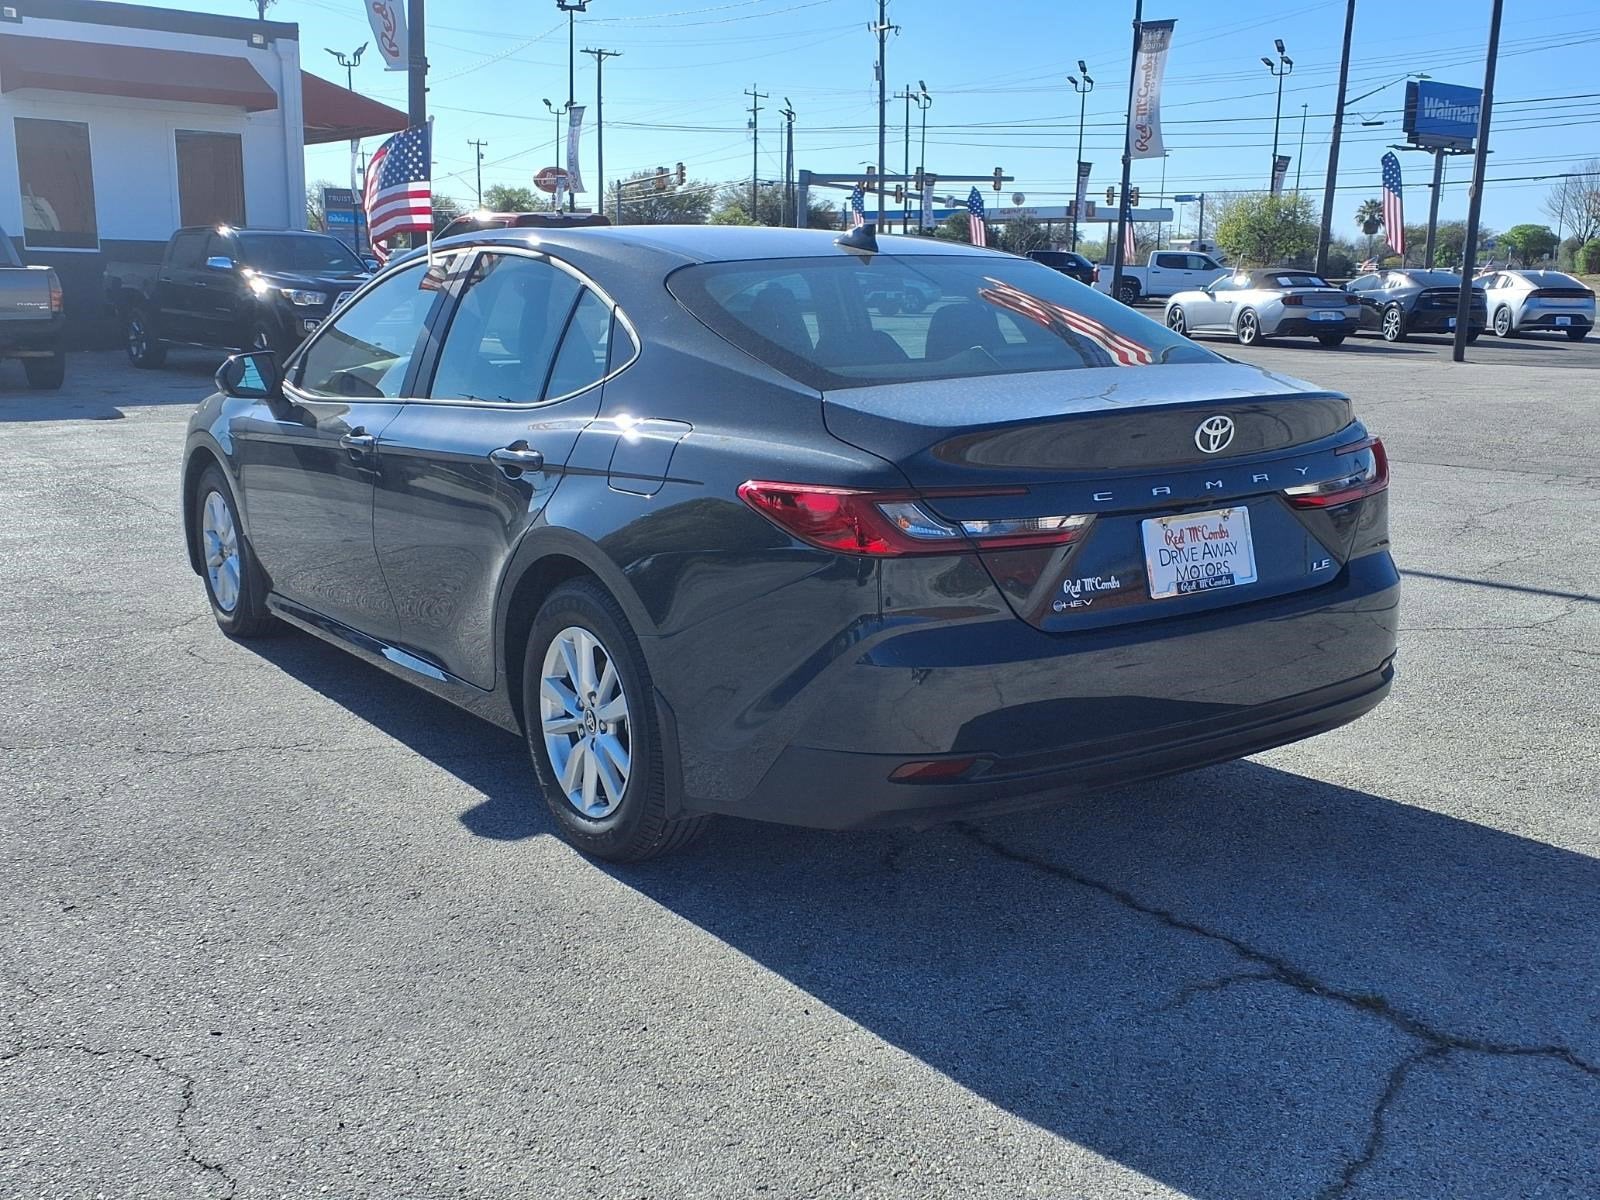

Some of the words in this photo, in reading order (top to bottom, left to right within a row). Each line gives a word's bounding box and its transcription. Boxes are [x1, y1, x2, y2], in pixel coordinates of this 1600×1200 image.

[1424, 96, 1480, 123] Walmart
[1134, 123, 1153, 152] Red
[1092, 466, 1309, 502] CAMRY
[1165, 529, 1185, 550] Red
[1186, 524, 1229, 544] McCombs
[1159, 546, 1198, 567] DRIVE
[1202, 541, 1238, 561] AWAY
[1311, 558, 1331, 572] LE
[1176, 560, 1231, 582] MOTORS
[1064, 579, 1081, 598] Red
[1081, 575, 1120, 591] McCombs
[1181, 580, 1198, 592] Red
